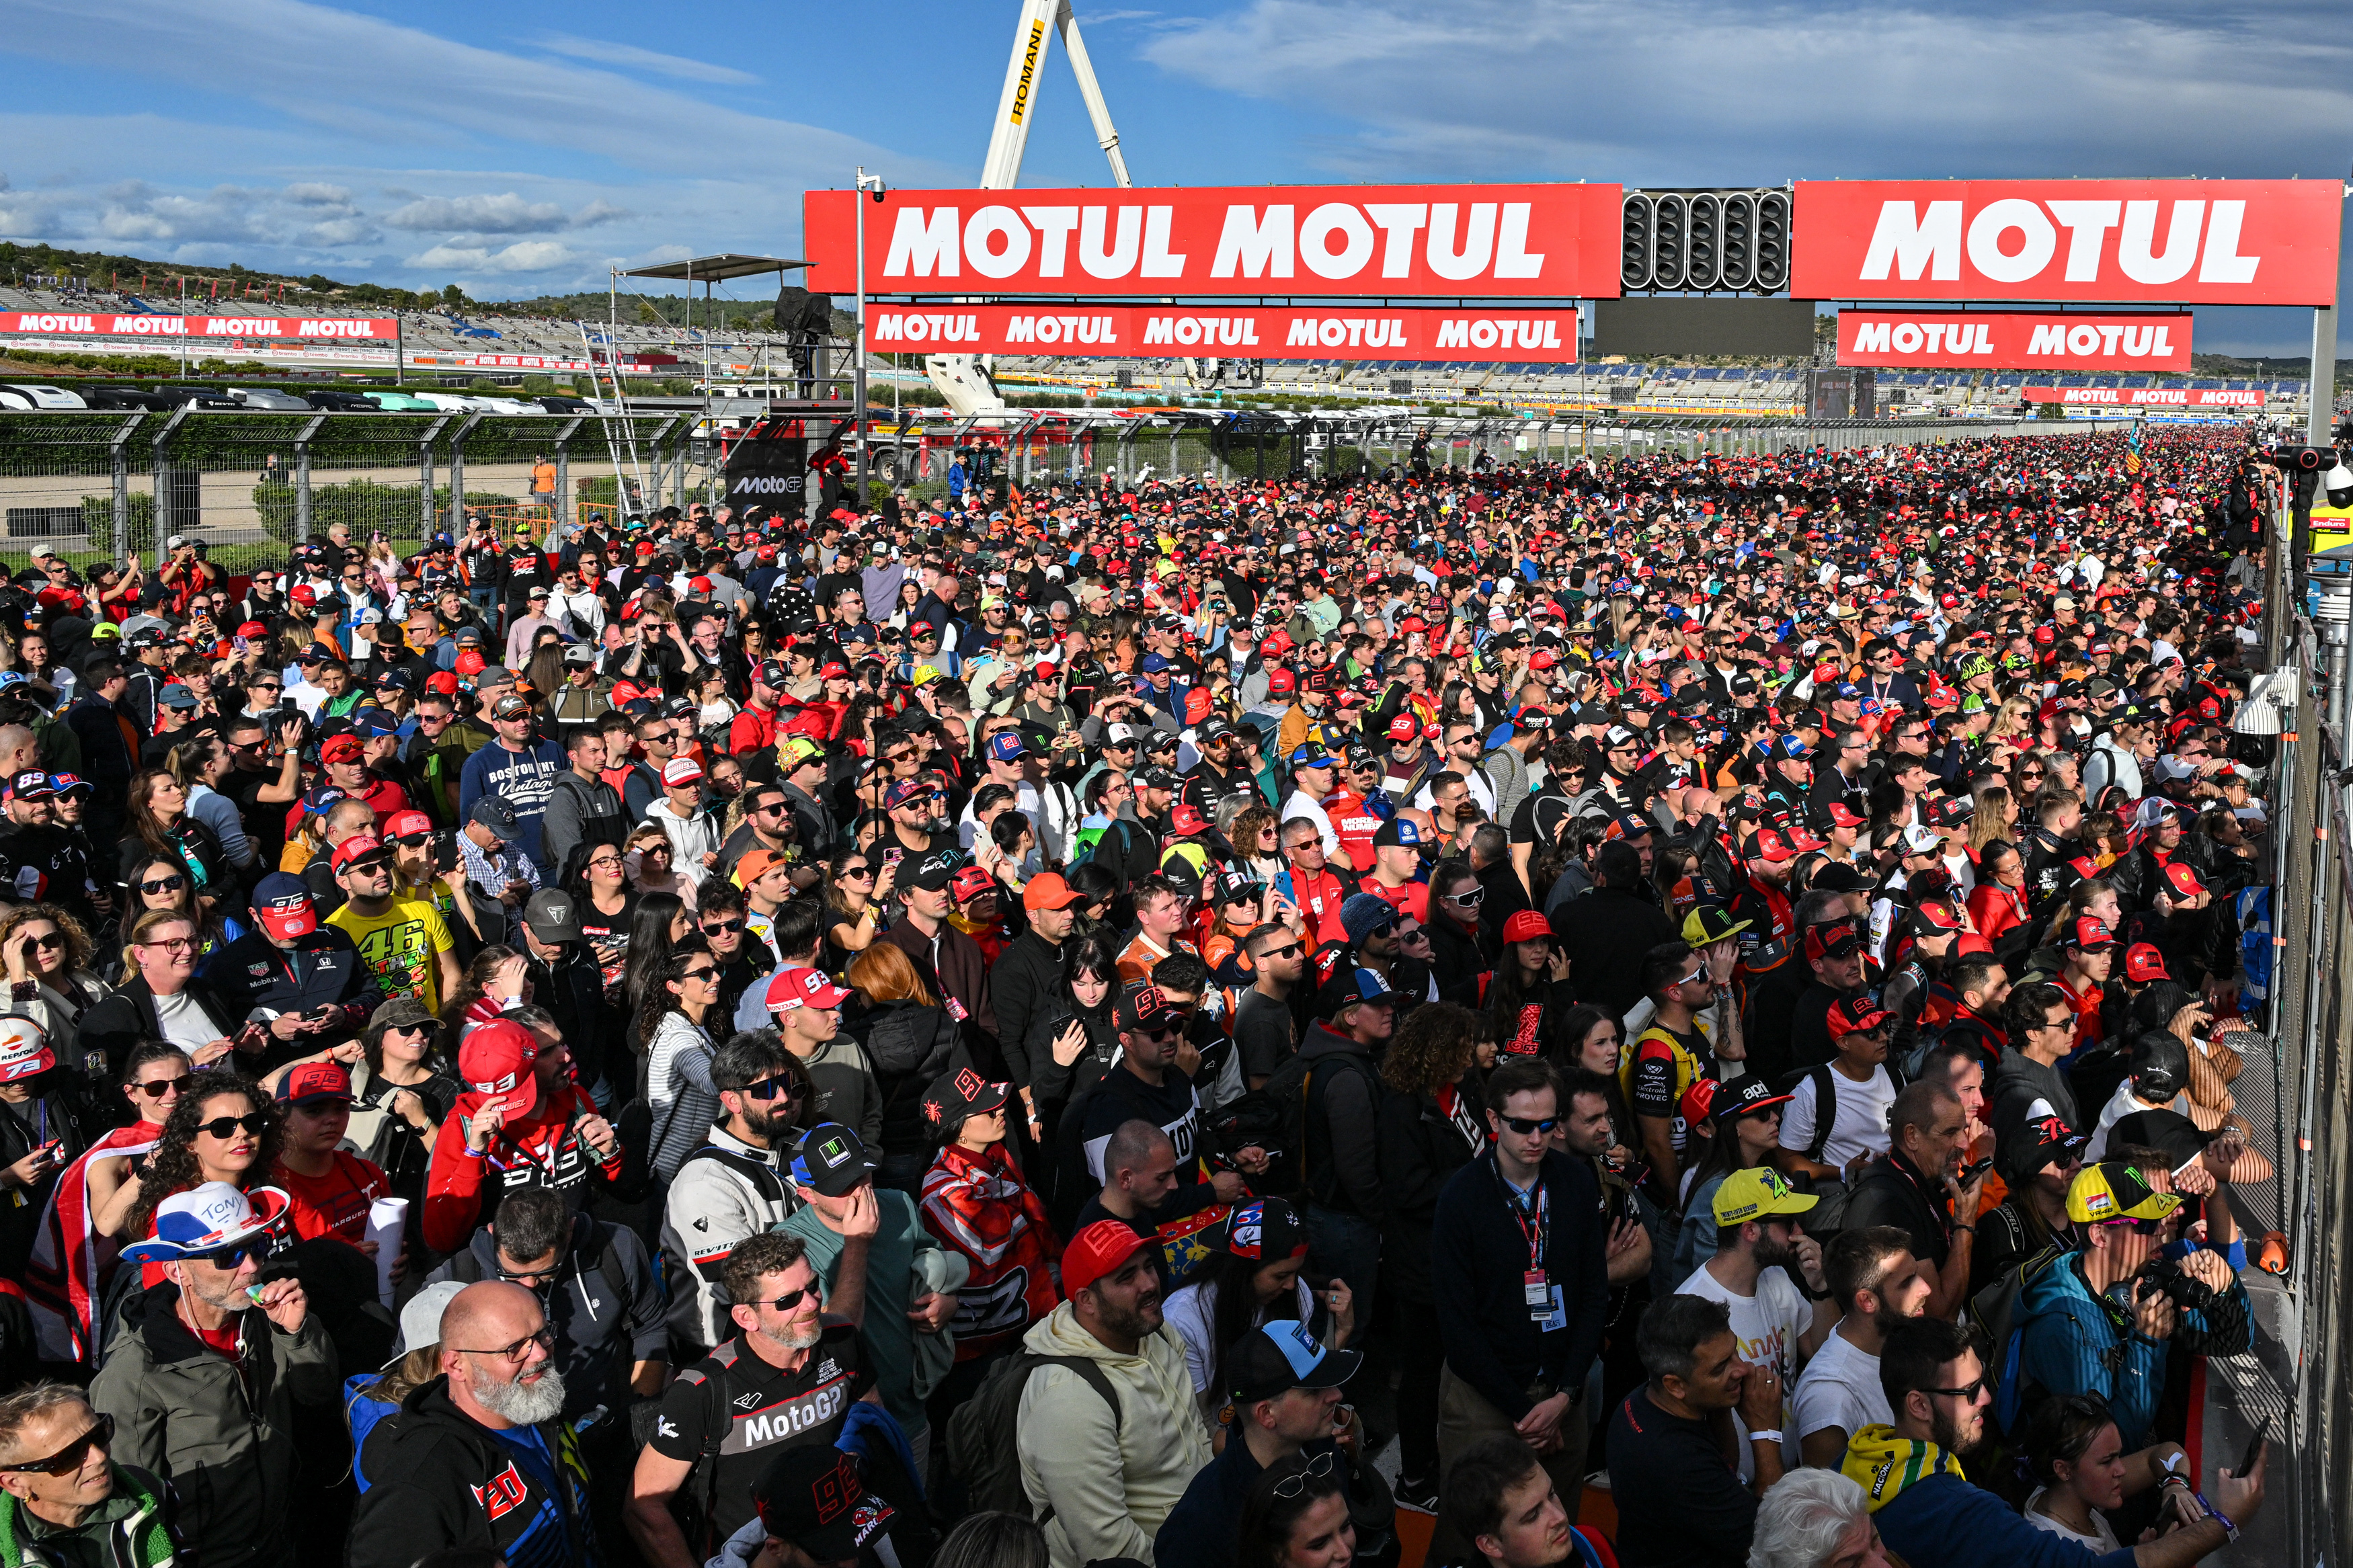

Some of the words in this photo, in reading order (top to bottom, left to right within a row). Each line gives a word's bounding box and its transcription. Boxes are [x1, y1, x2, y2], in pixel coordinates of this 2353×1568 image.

[1013, 28, 1042, 117] ROMANI
[883, 205, 1187, 278] MOTUL
[1210, 203, 1545, 279] MOTUL
[1859, 198, 2261, 284] MOTUL
[19, 315, 95, 332] MOTUL
[112, 317, 189, 334] MOTUL
[206, 319, 282, 335] MOTUL
[298, 320, 374, 337] MOTUL
[875, 314, 981, 341] MOTUL
[1005, 315, 1117, 343] MOTUL
[1144, 317, 1259, 346] MOTUL
[1286, 318, 1407, 347] MOTUL
[1435, 319, 1562, 349] MOTUL
[1853, 323, 1995, 355] MOTUL
[2026, 325, 2175, 357] MOTUL
[479, 356, 496, 365] MOTUL
[500, 356, 518, 366] MOTUL
[522, 358, 540, 367] MOTUL
[2064, 389, 2119, 403] MOTUL
[2131, 390, 2188, 403] MOTUL
[2200, 390, 2258, 405] MOTUL
[732, 475, 803, 494] MotoGP
[468, 556, 476, 578] DUCATI
[925, 666, 939, 676] 46
[1864, 699, 1879, 710] 20
[1392, 719, 1411, 730] 93
[1429, 723, 1443, 732] 93
[1002, 735, 1019, 750] 20
[19, 772, 45, 789] 89
[489, 763, 535, 784] BOSTON
[1728, 807, 1736, 817] 93
[401, 814, 432, 834] 63
[1343, 823, 1383, 831] NUMBE
[1226, 872, 1248, 891] 31
[361, 918, 425, 960] 46
[376, 951, 420, 973] THE
[251, 968, 268, 977] HEUER
[804, 969, 830, 995] 93
[767, 1000, 796, 1012] HONDA
[1135, 986, 1170, 1020] 93
[1853, 997, 1875, 1015] 93
[1504, 1003, 1544, 1057] 1
[2, 1048, 36, 1061] REPSOL
[6, 1059, 41, 1079] 73
[303, 1069, 344, 1089] 93
[475, 1072, 516, 1094] 93
[1636, 1091, 1667, 1102] PROVEC
[1638, 1084, 1667, 1094] Electrolit
[833, 1151, 849, 1163] YAMAHA
[201, 1195, 244, 1220] TONY
[1720, 1207, 1743, 1219] TWENTY-FIFTH
[1743, 1202, 1758, 1212] SEASON
[694, 1241, 734, 1255] REV'IT!
[745, 1385, 842, 1448] MotoGP
[469, 1458, 529, 1524] 20
[812, 1454, 863, 1525] 93
